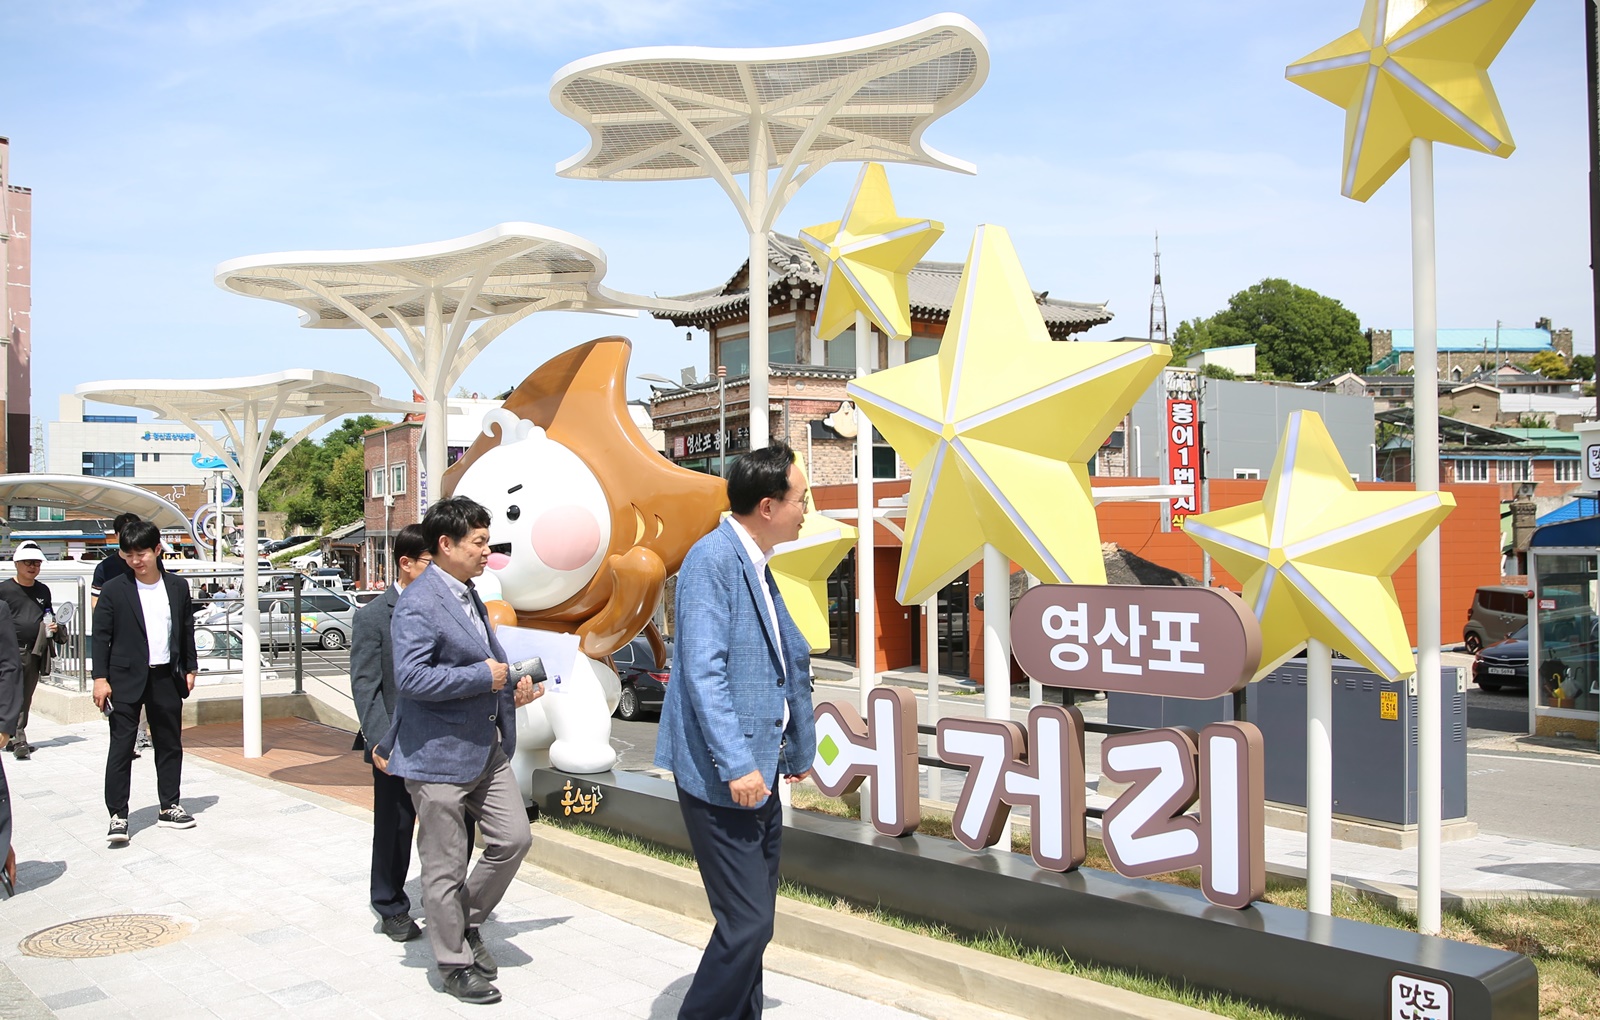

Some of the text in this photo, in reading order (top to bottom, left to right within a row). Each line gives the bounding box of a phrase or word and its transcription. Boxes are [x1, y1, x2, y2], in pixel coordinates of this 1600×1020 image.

[686, 432, 711, 454] 영산포
[1171, 402, 1196, 511] 홍어1번지
[1171, 514, 1187, 530] 식
[1041, 602, 1205, 676] 영산포
[1386, 702, 1396, 711] S14
[561, 780, 599, 816] 홍스타
[1399, 984, 1441, 1011] 맛도
